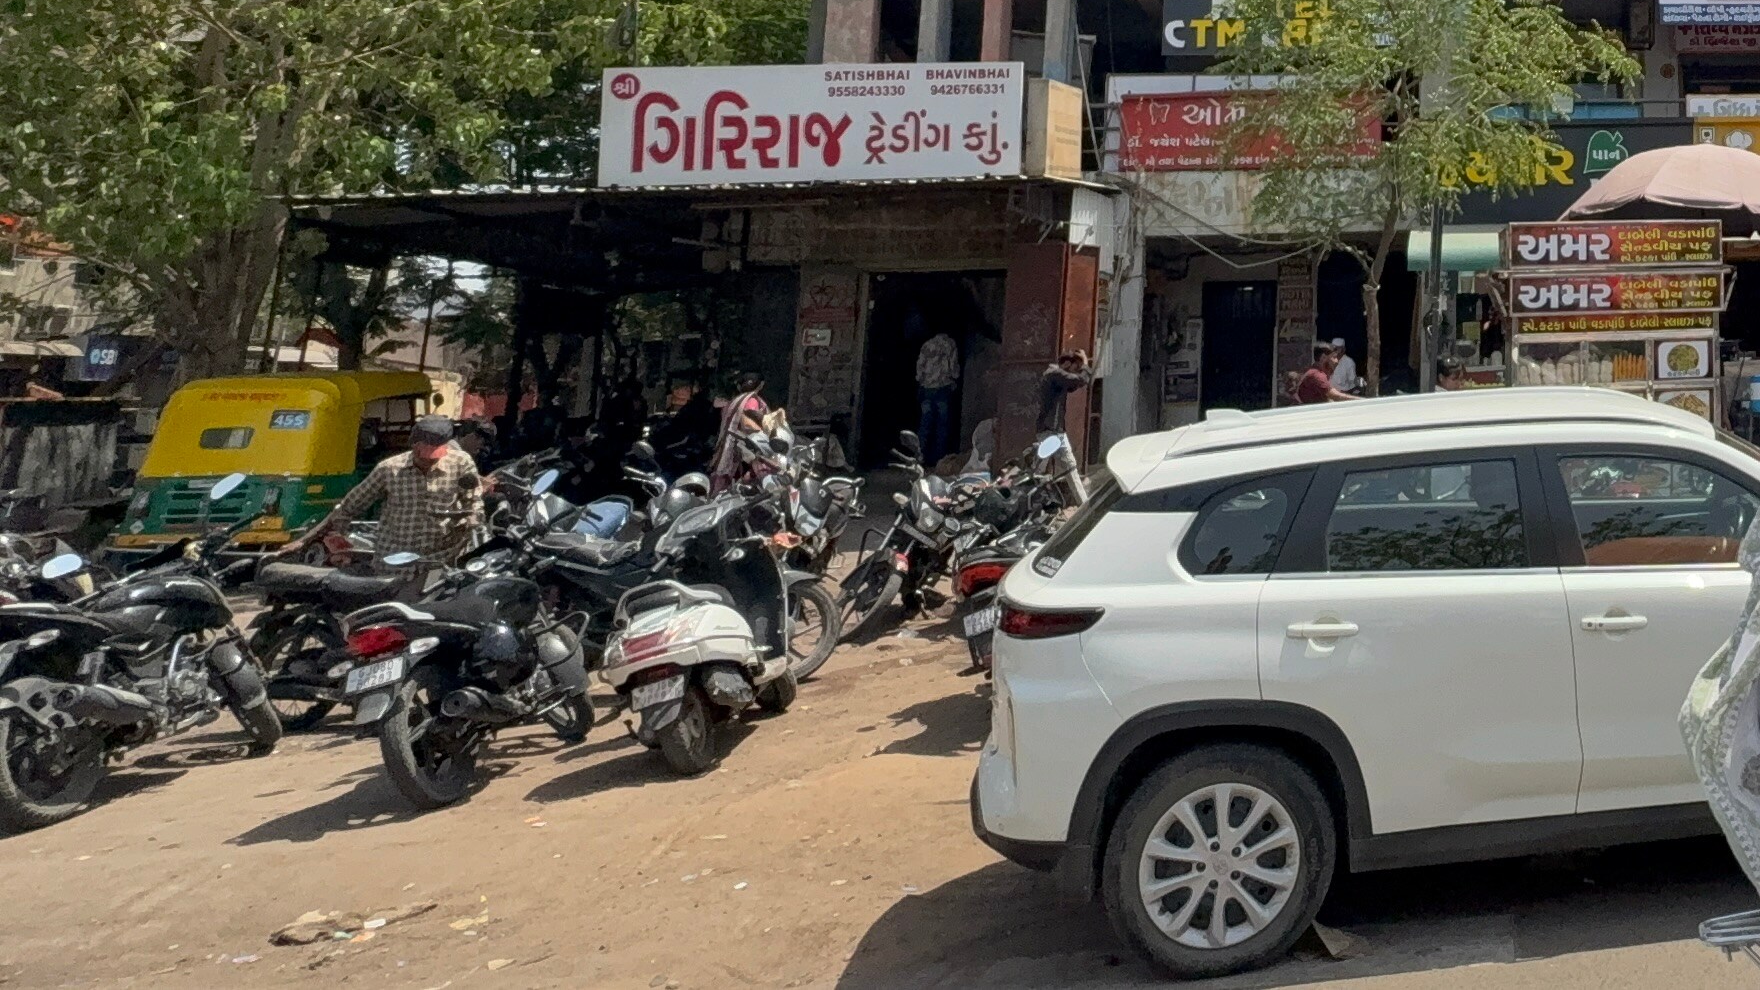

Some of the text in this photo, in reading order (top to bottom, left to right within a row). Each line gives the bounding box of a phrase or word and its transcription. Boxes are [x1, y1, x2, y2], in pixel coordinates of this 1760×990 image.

[1164, 19, 1246, 48] CTM
[824, 67, 1011, 81] SATISHBHAI BHAVINBHAI
[611, 76, 639, 97] શ્રી
[828, 83, 1005, 98] 9558243330 9426766331
[631, 89, 852, 173] ગિરિરાજ
[863, 109, 951, 165] ટ્રેડીંગ
[1591, 149, 1621, 161] પાન
[1518, 233, 1611, 261] અમર
[1618, 228, 1661, 241] દાબેલી
[1518, 283, 1612, 309] અમર
[1629, 315, 1660, 329] દાબેલી
